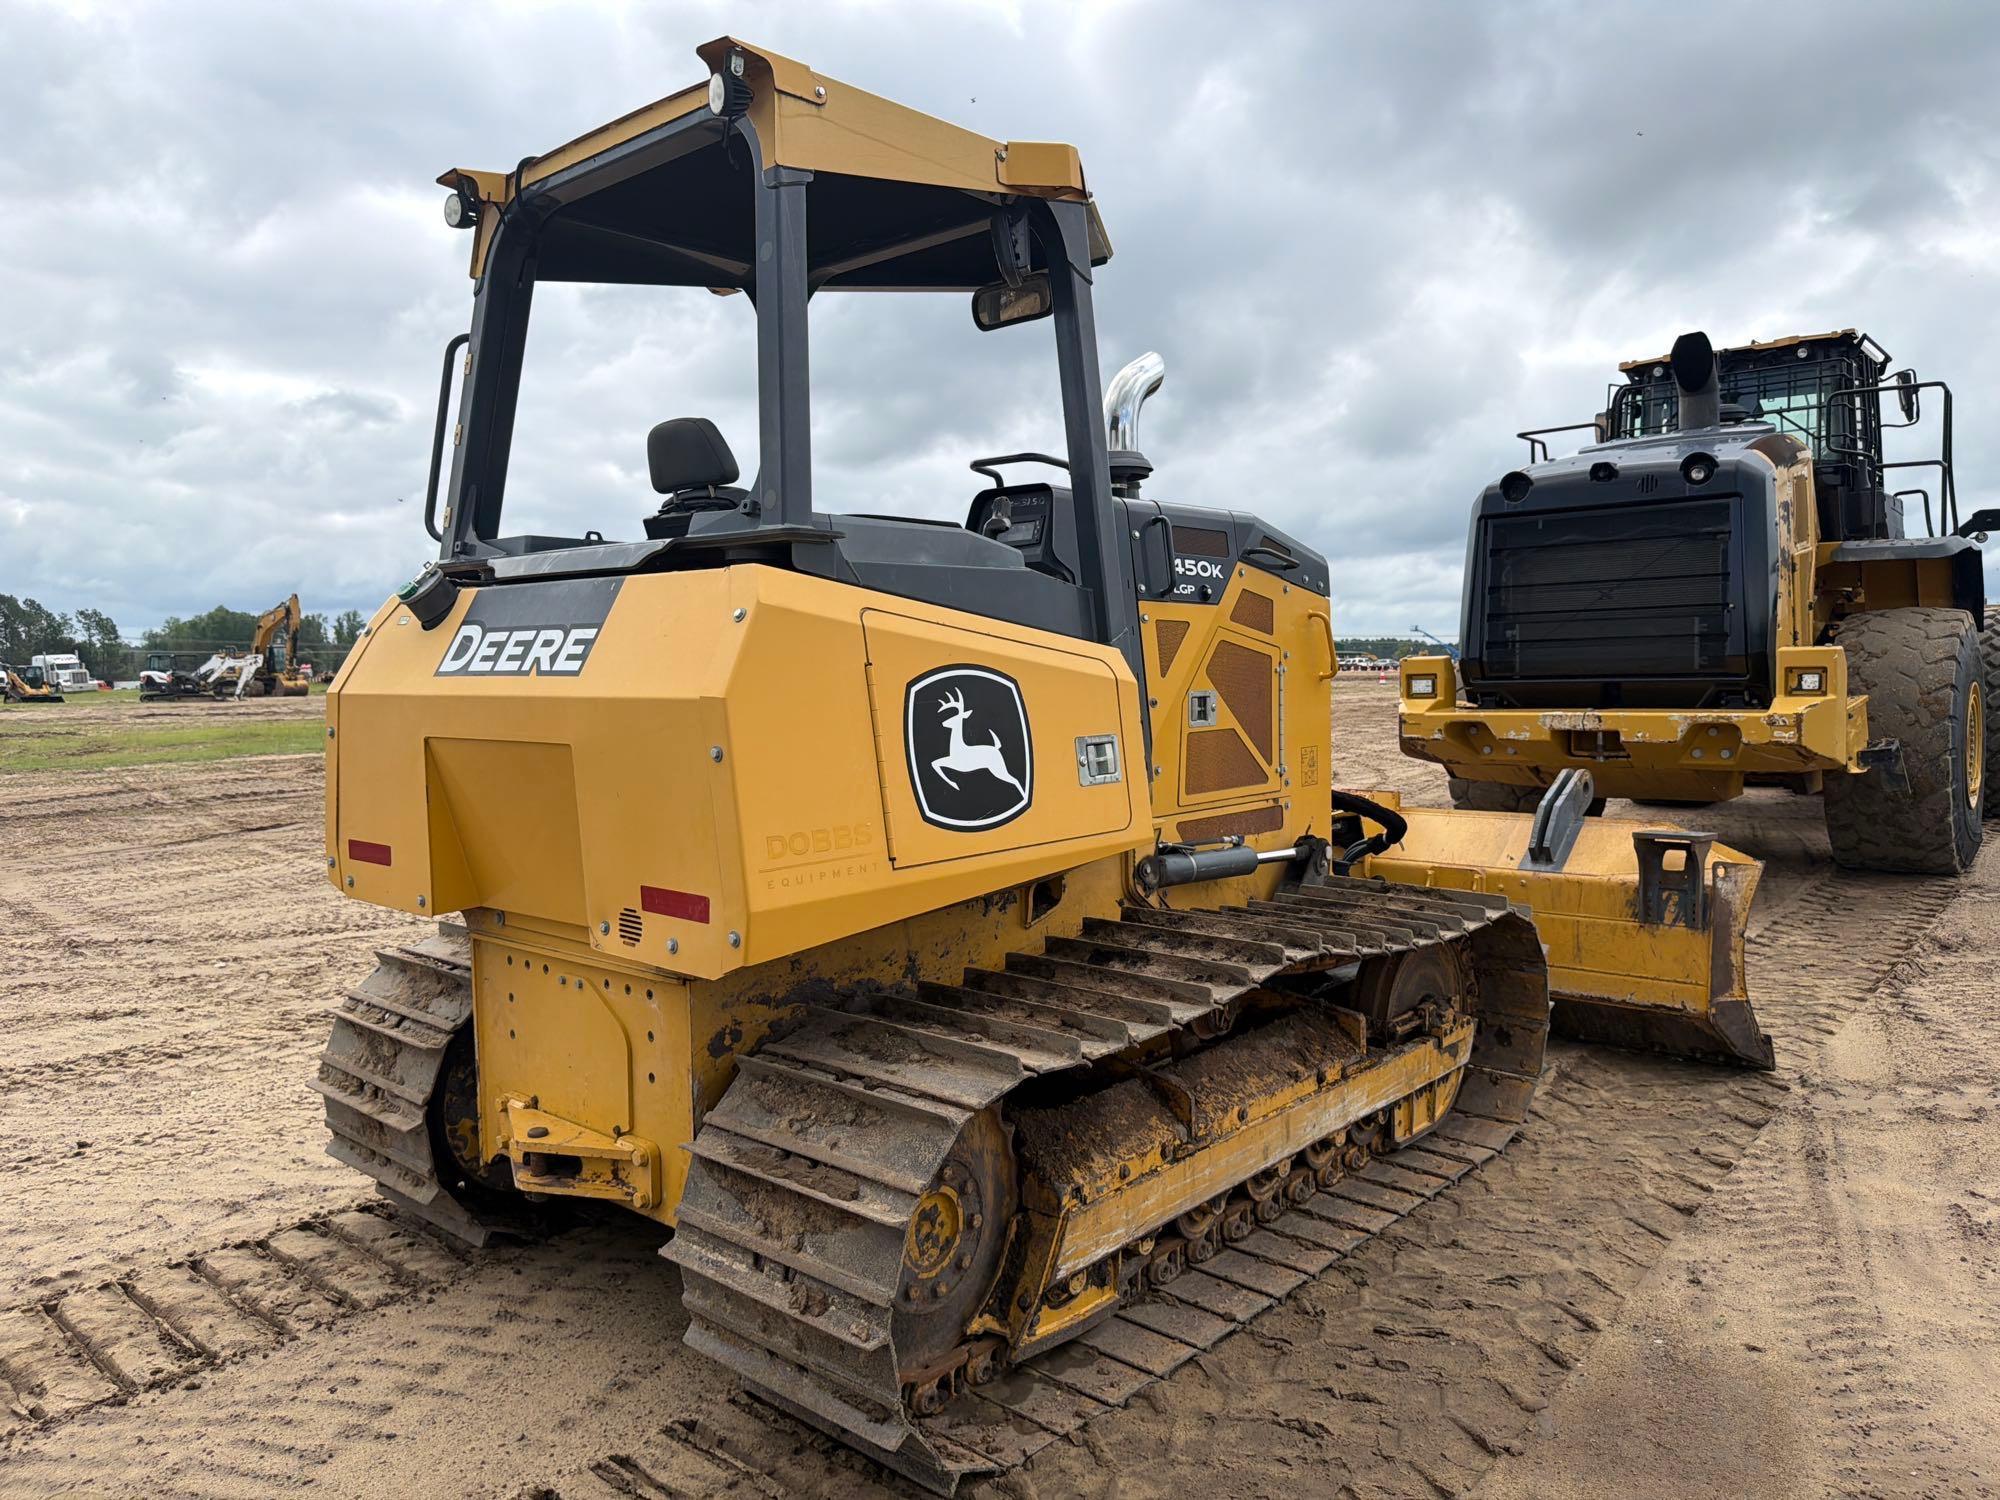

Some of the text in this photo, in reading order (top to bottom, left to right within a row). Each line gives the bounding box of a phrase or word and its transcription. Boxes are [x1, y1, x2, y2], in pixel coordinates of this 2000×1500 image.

[1174, 558, 1224, 579] 450K
[438, 624, 599, 672] DEERE
[766, 823, 873, 860] DOBBS
[767, 862, 880, 890] EQUIPMENT
